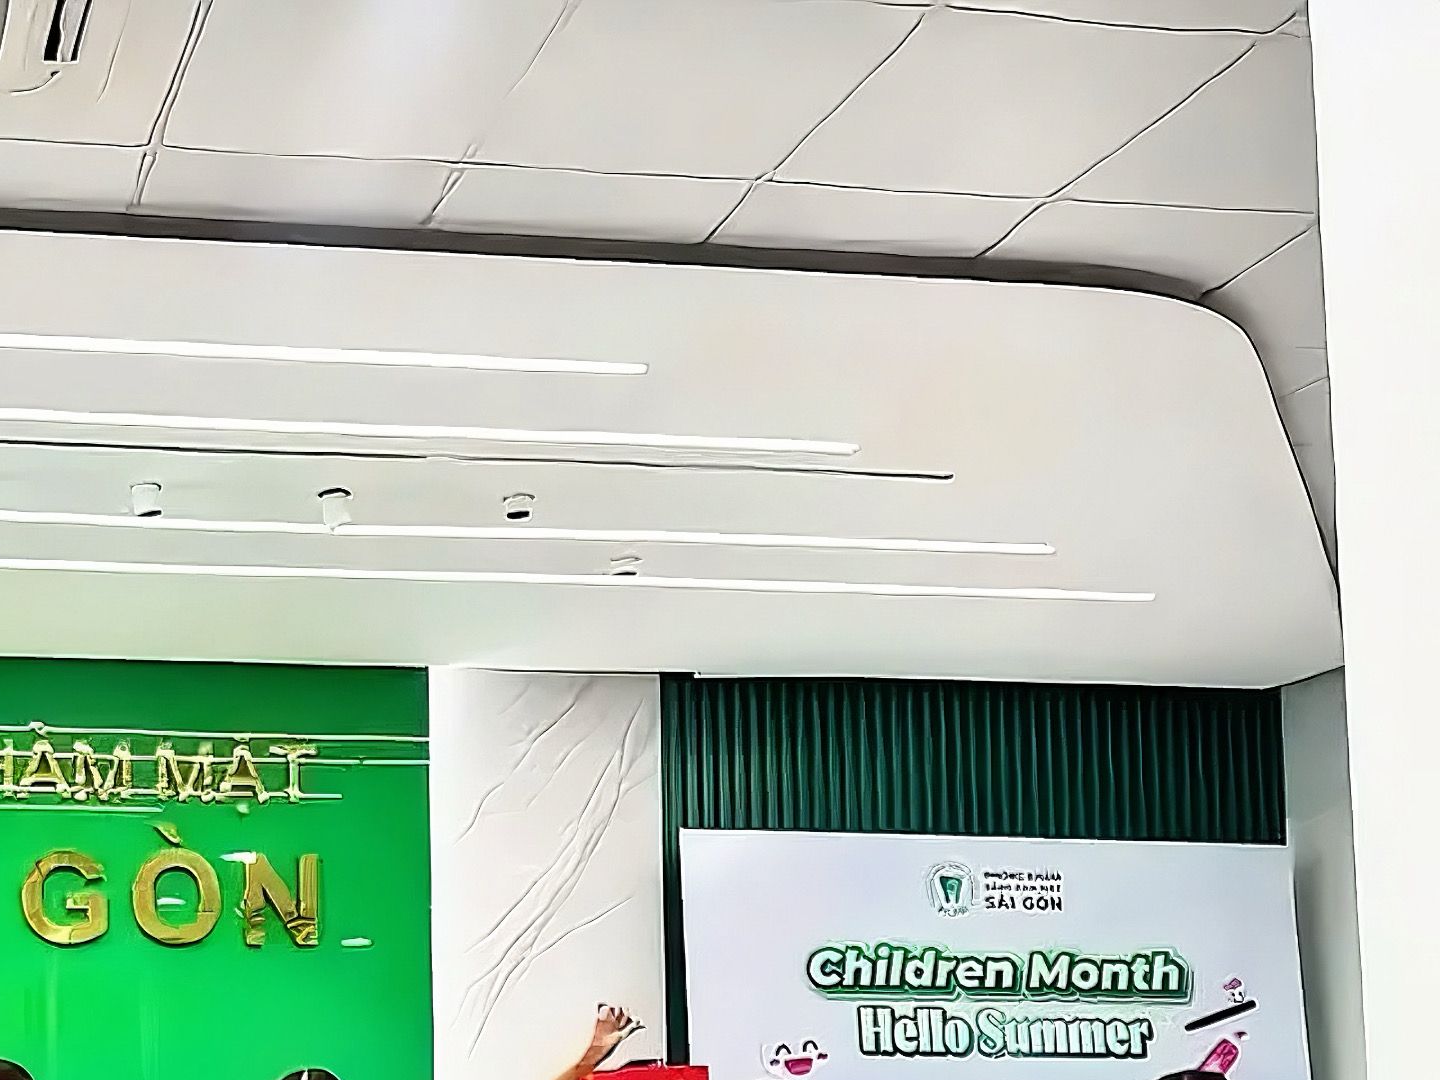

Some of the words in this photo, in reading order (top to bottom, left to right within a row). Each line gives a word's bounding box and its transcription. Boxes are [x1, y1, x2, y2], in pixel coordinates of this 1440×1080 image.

[21, 819, 320, 948] GÒN
[807, 943, 1020, 995] Children
[1024, 949, 1185, 996] Month
[859, 1006, 972, 1057] Hello
[977, 1008, 1154, 1058] Summer
